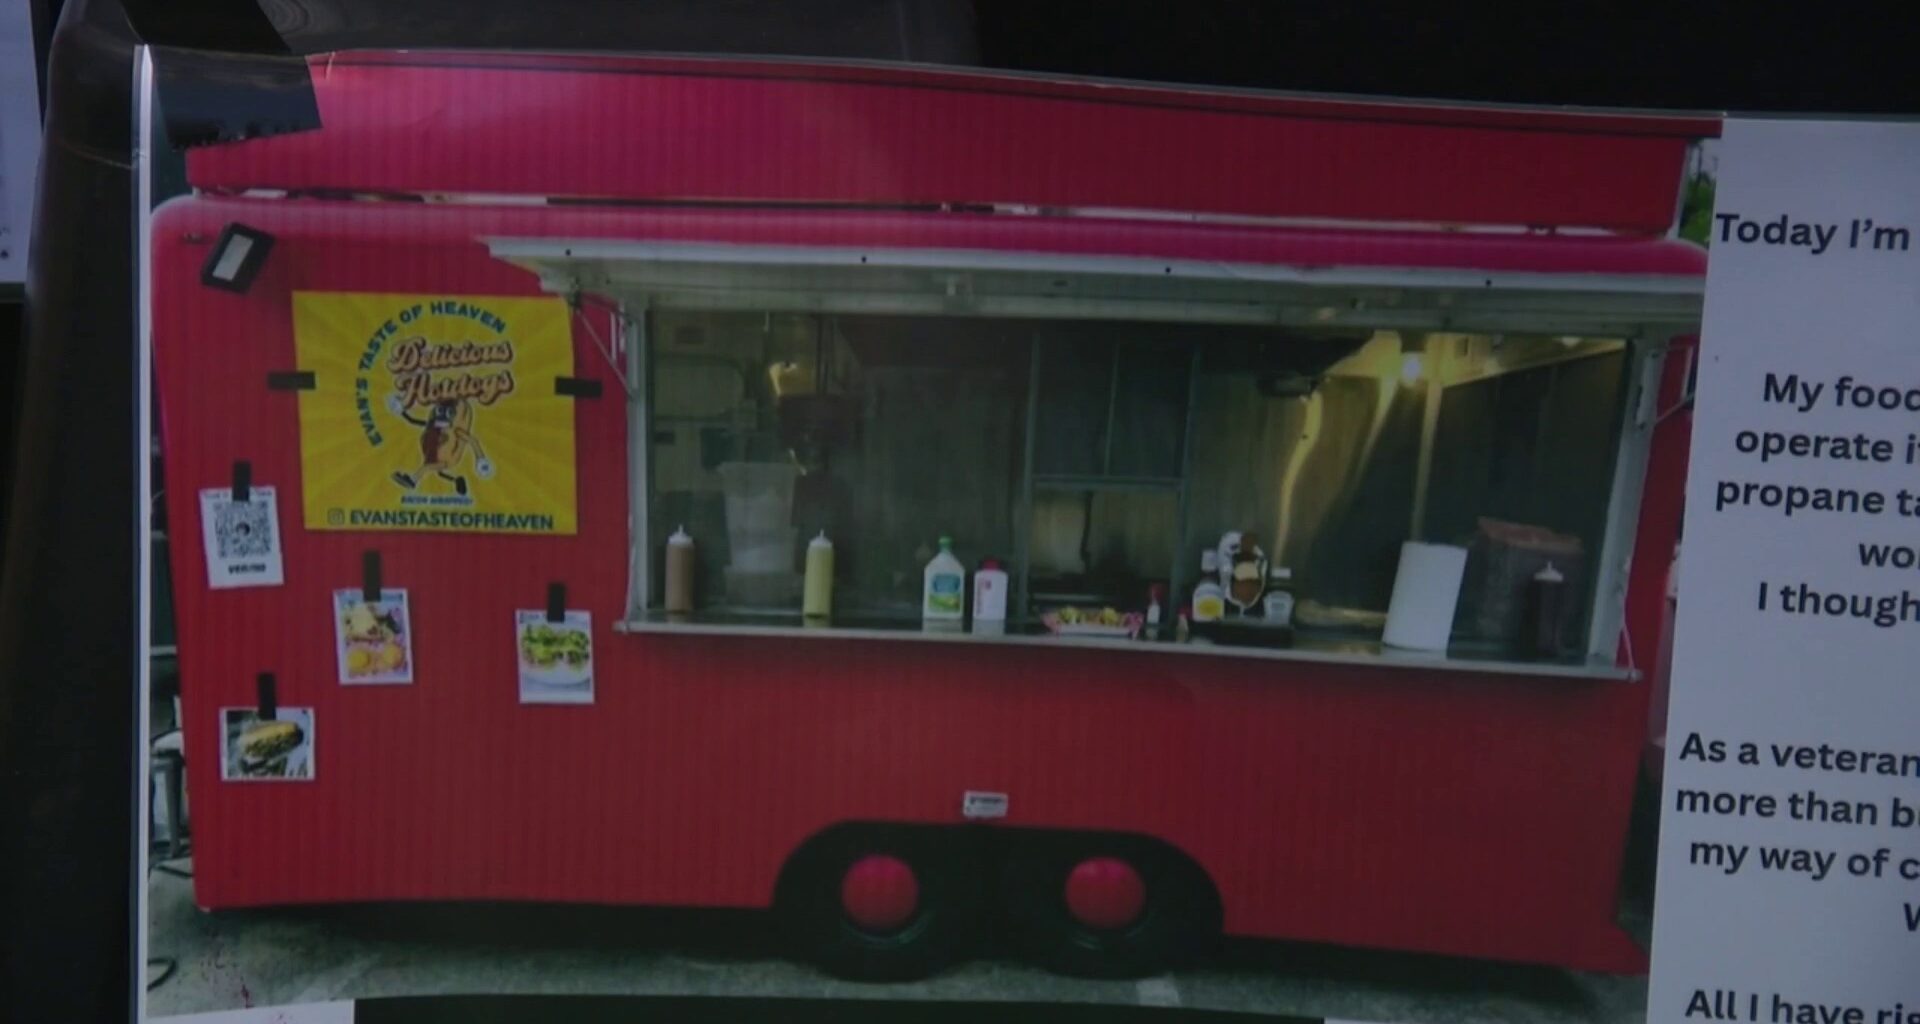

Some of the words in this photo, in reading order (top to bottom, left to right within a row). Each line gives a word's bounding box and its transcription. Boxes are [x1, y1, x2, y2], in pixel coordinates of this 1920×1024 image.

[1715, 213, 1838, 255] Today
[1848, 218, 1911, 252] I’m
[359, 319, 397, 370] TASTE
[399, 304, 422, 323] OF
[430, 301, 506, 333] HEAVEN
[387, 337, 514, 373] Delicious
[395, 370, 514, 408] Hotdogs
[1763, 372, 1823, 413] My
[1735, 430, 1894, 464] operate
[1905, 434, 1920, 464] i
[1716, 480, 1886, 518] propane
[350, 511, 554, 530] EVANSTASTEOFHEAVEN
[1858, 542, 1920, 570] wo
[1758, 580, 1769, 611] I
[1679, 732, 1727, 763] As
[1737, 742, 1761, 766] a
[1771, 744, 1920, 778] veteran
[1676, 789, 1777, 819] more
[1788, 790, 1879, 826] than
[1891, 797, 1920, 828] b
[1690, 842, 1749, 875] my
[1760, 847, 1837, 881] way
[1847, 848, 1891, 878] of
[1685, 989, 1738, 1021] All
[1749, 993, 1758, 1022] I
[1771, 993, 1865, 1024] have
